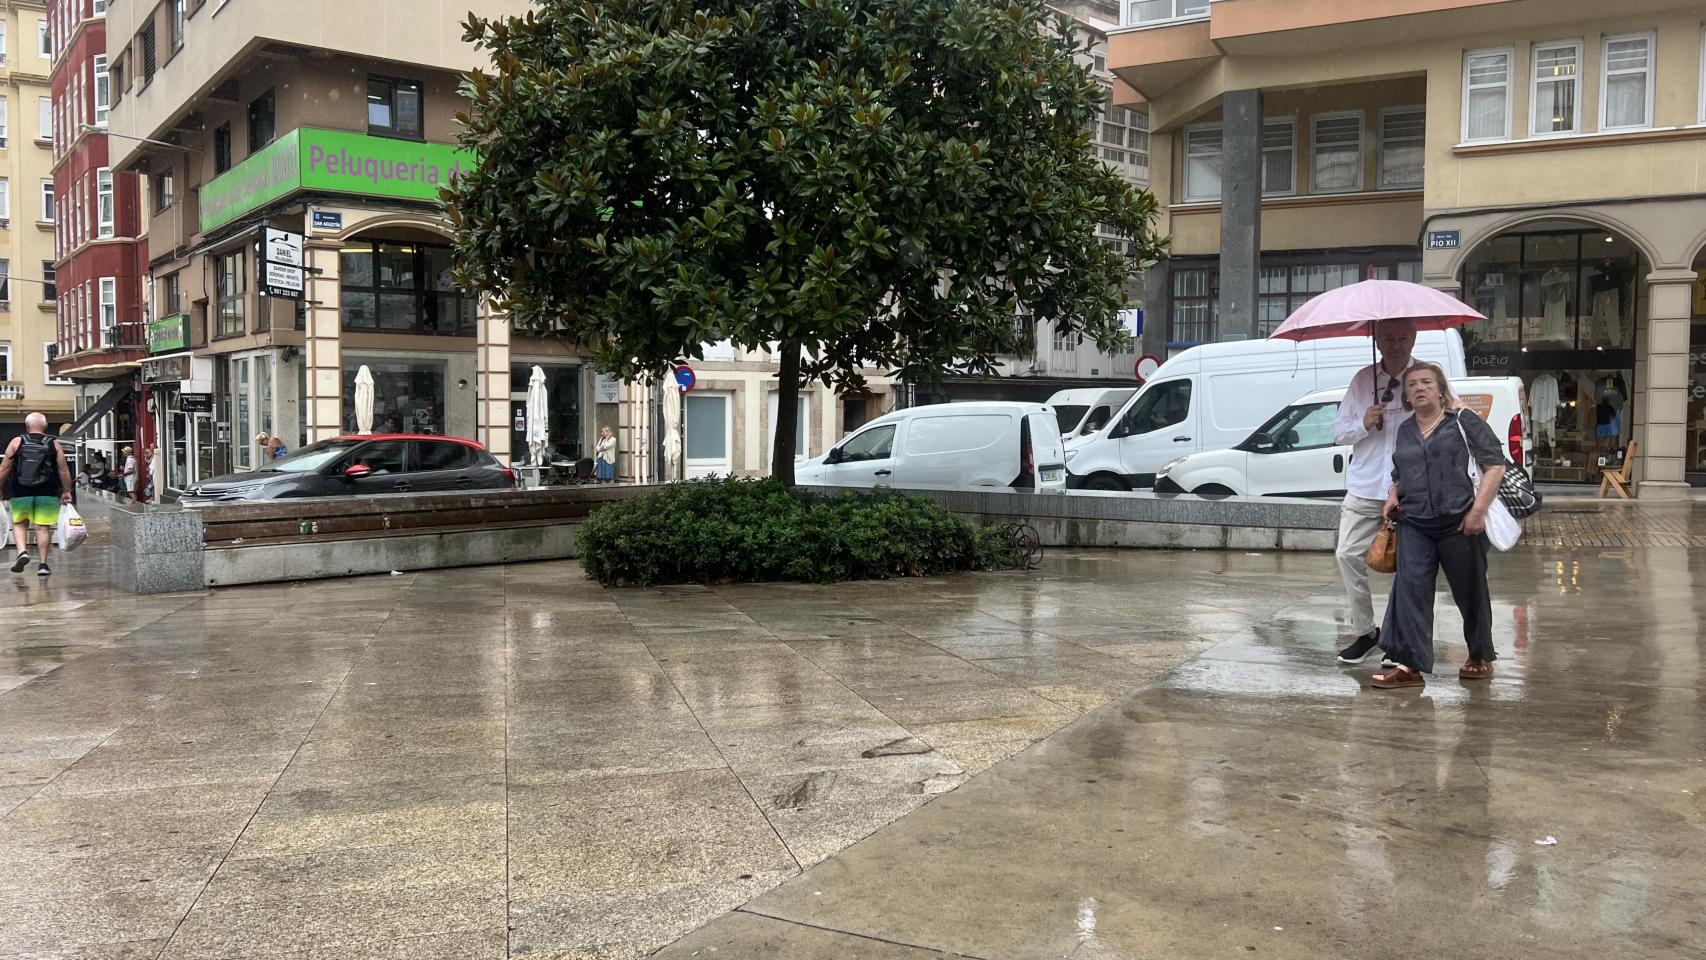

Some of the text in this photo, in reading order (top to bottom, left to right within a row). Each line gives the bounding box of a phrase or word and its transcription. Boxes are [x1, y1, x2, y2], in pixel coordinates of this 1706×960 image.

[309, 145, 440, 185] Peluqueria
[1430, 240, 1444, 248] PIO
[276, 247, 292, 258] DANIEL
